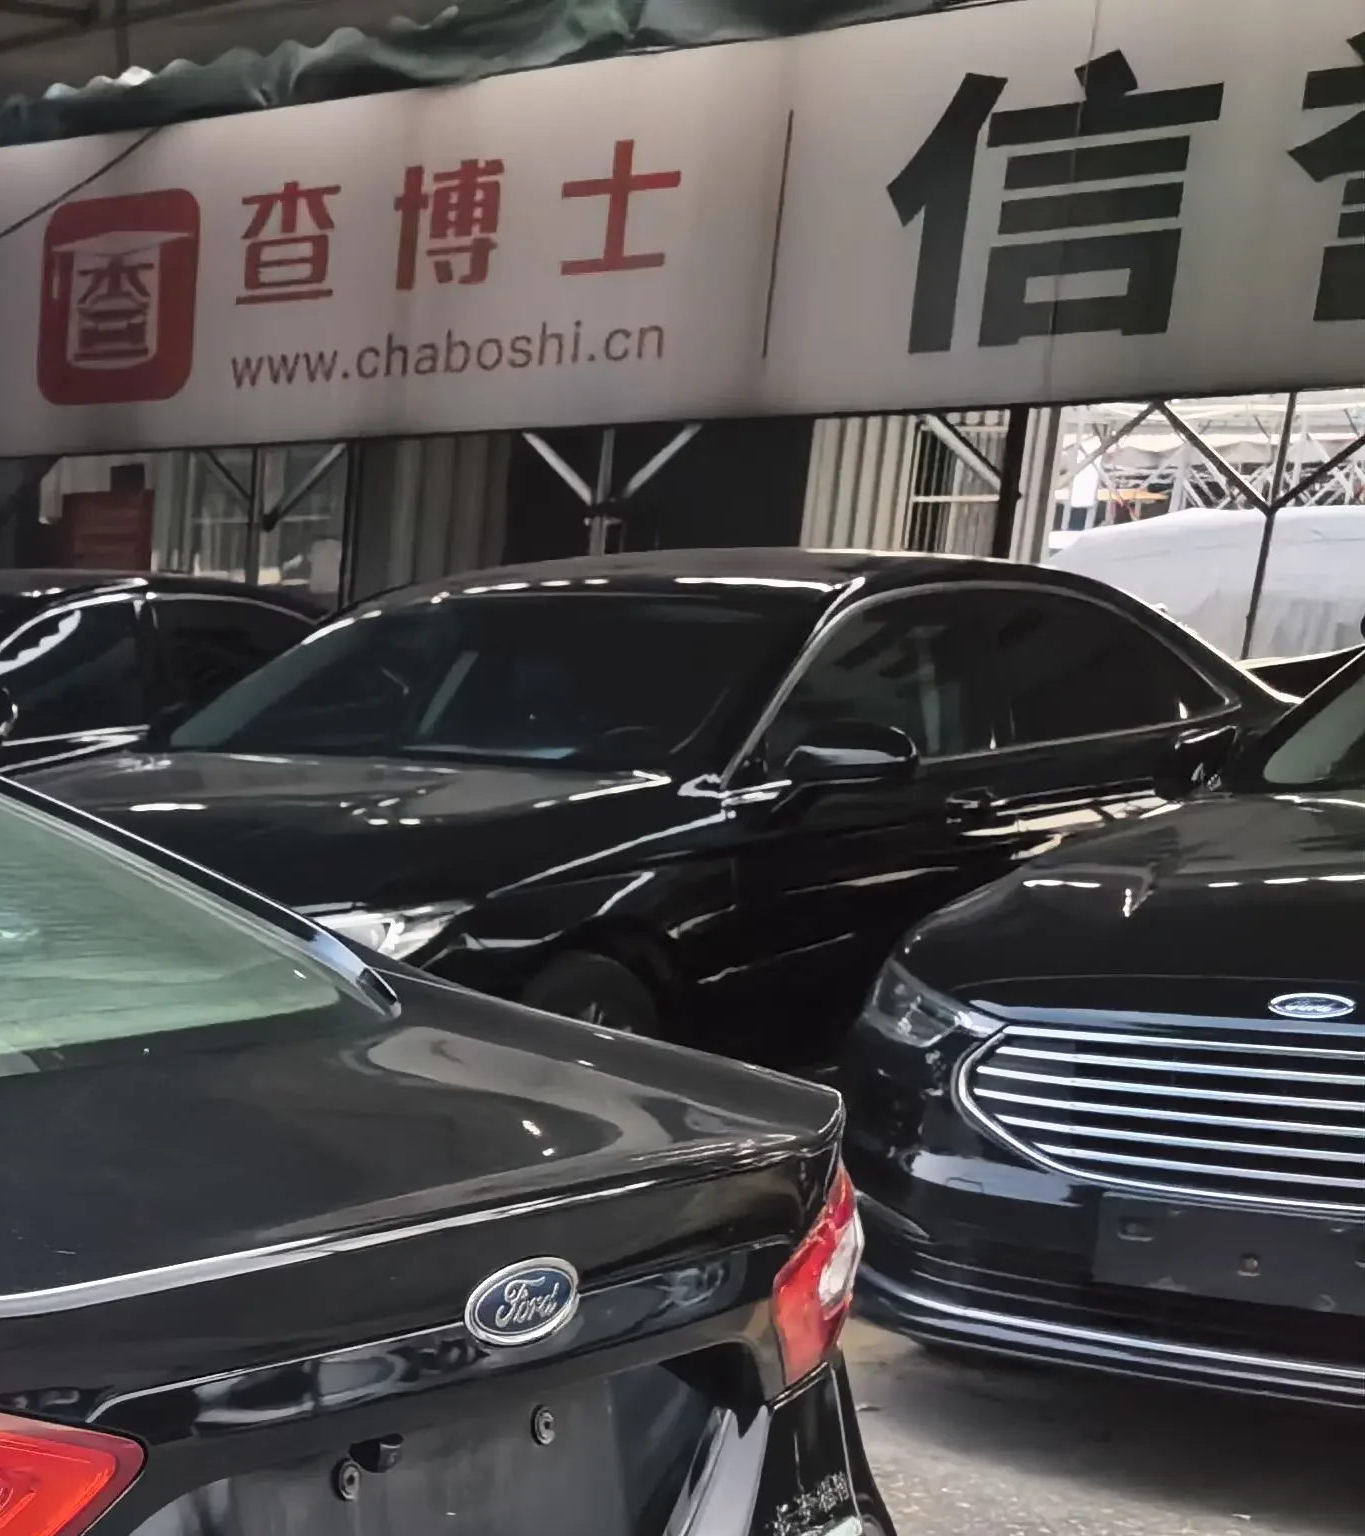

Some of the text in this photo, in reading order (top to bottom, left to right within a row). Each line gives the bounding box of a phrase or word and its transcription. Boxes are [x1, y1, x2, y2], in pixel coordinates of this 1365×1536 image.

[235, 139, 682, 306] 查博士
[887, 32, 1365, 353] 信
[231, 320, 666, 389] www.chaboshi.cn
